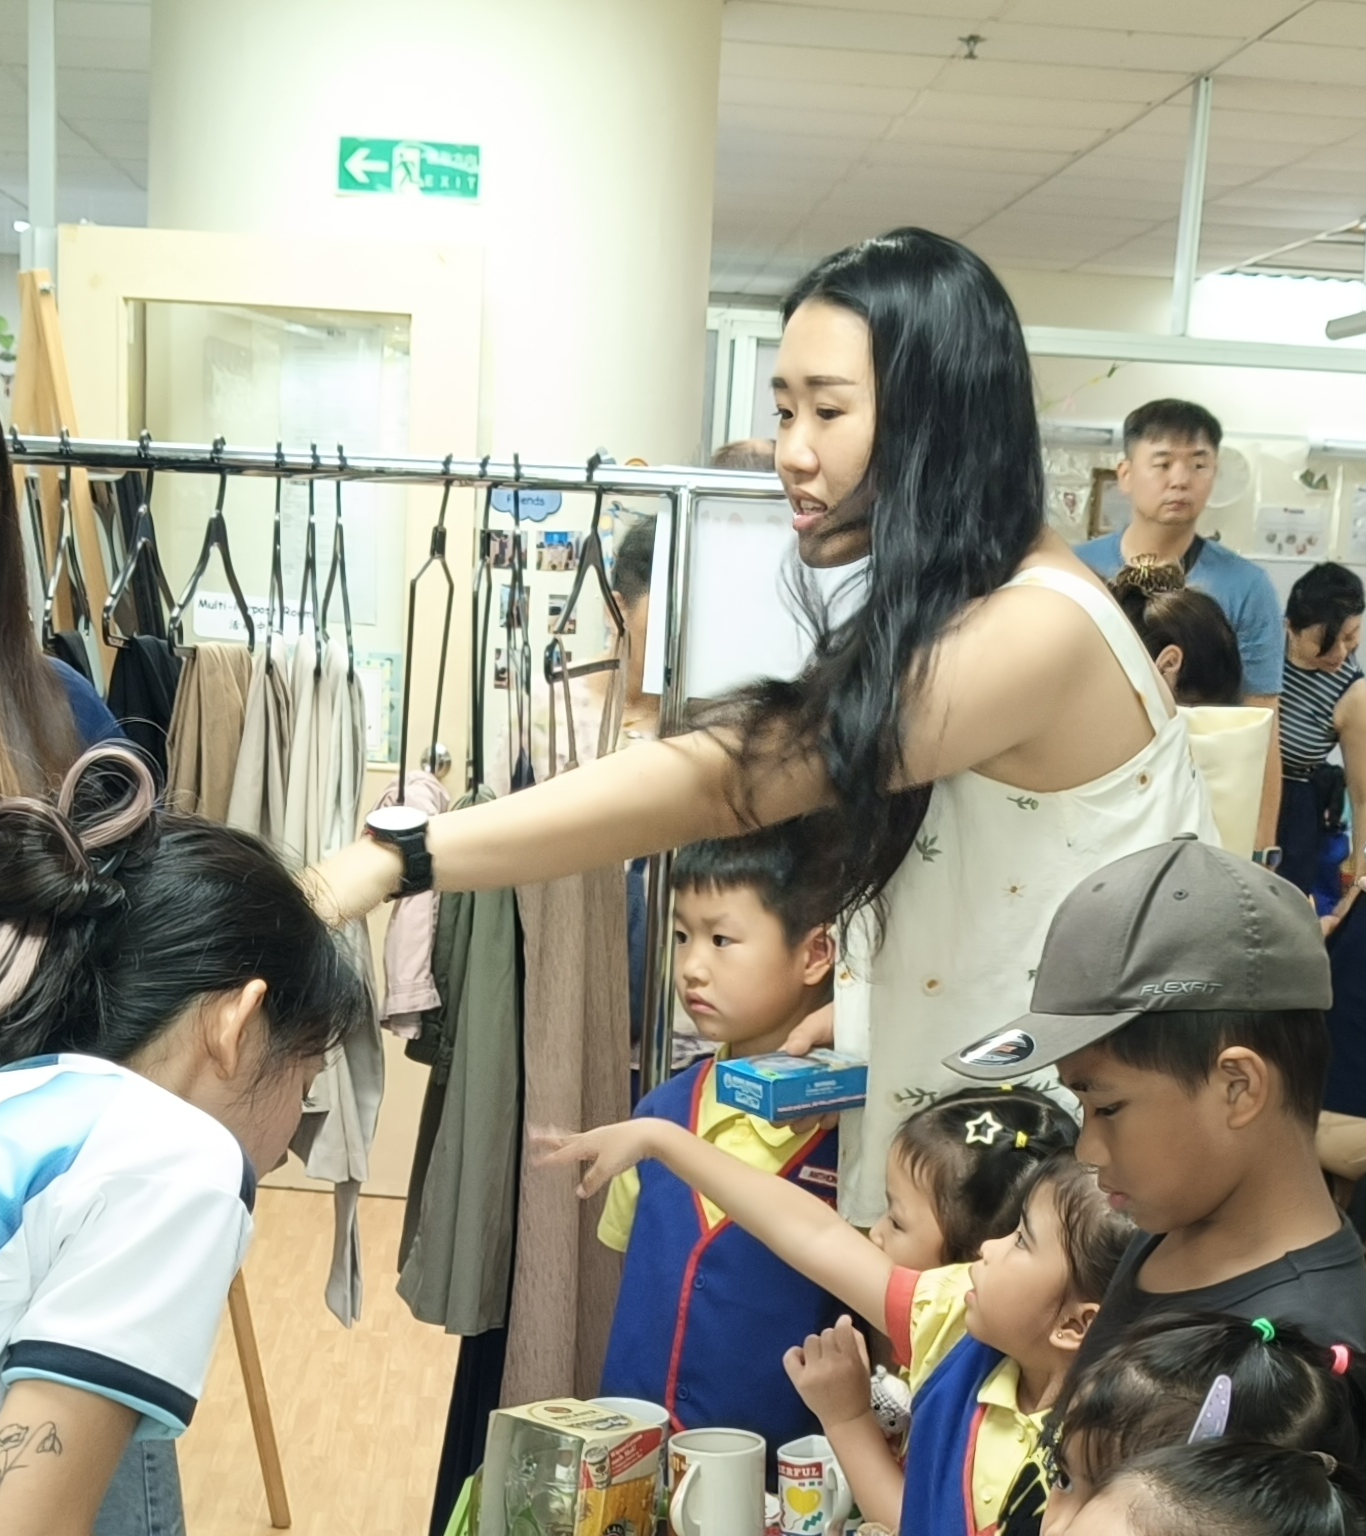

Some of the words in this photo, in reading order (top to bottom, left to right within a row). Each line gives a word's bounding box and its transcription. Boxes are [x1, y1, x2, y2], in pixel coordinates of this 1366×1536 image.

[424, 174, 476, 191] EXIT
[506, 493, 546, 506] Fends
[1139, 981, 1223, 996] FLEXFIT
